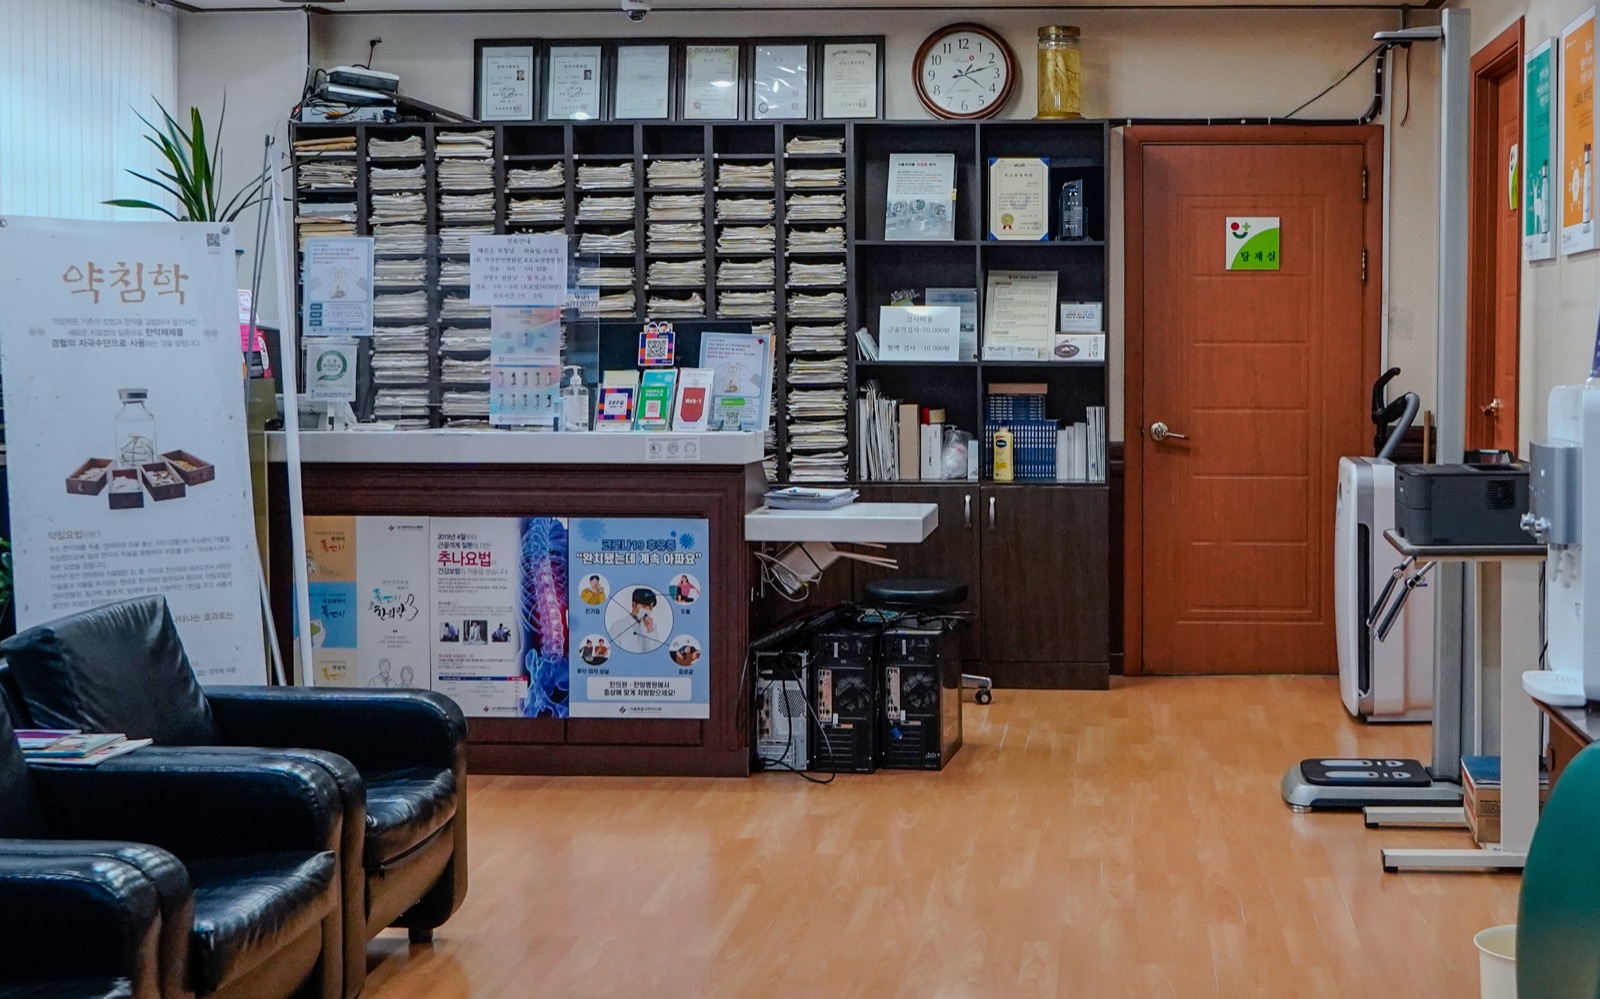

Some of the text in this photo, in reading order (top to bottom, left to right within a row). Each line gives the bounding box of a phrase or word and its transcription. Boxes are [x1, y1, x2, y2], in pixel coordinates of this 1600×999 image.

[943, 43, 952, 54] 11
[958, 38, 969, 50] 12
[977, 42, 982, 52] 1
[931, 55, 941, 65] 10
[988, 53, 995, 64] 2
[928, 70, 935, 81] 9
[993, 68, 1000, 79] 3
[933, 86, 941, 96] 8
[989, 83, 996, 93] 4
[946, 97, 953, 107] 7
[961, 100, 968, 111] 6
[978, 95, 984, 106] 5
[63, 261, 189, 304] 약침학
[904, 344, 916, 352] 검사
[437, 533, 456, 541] 2019년
[601, 539, 676, 551] 코로나19 후유증
[640, 552, 660, 565] 계속
[373, 603, 407, 620] 한의약
[609, 681, 628, 689] 한의원
[633, 681, 670, 689] 한방병원에서
[604, 689, 621, 697] 증상에
[623, 689, 636, 697] 맞게
